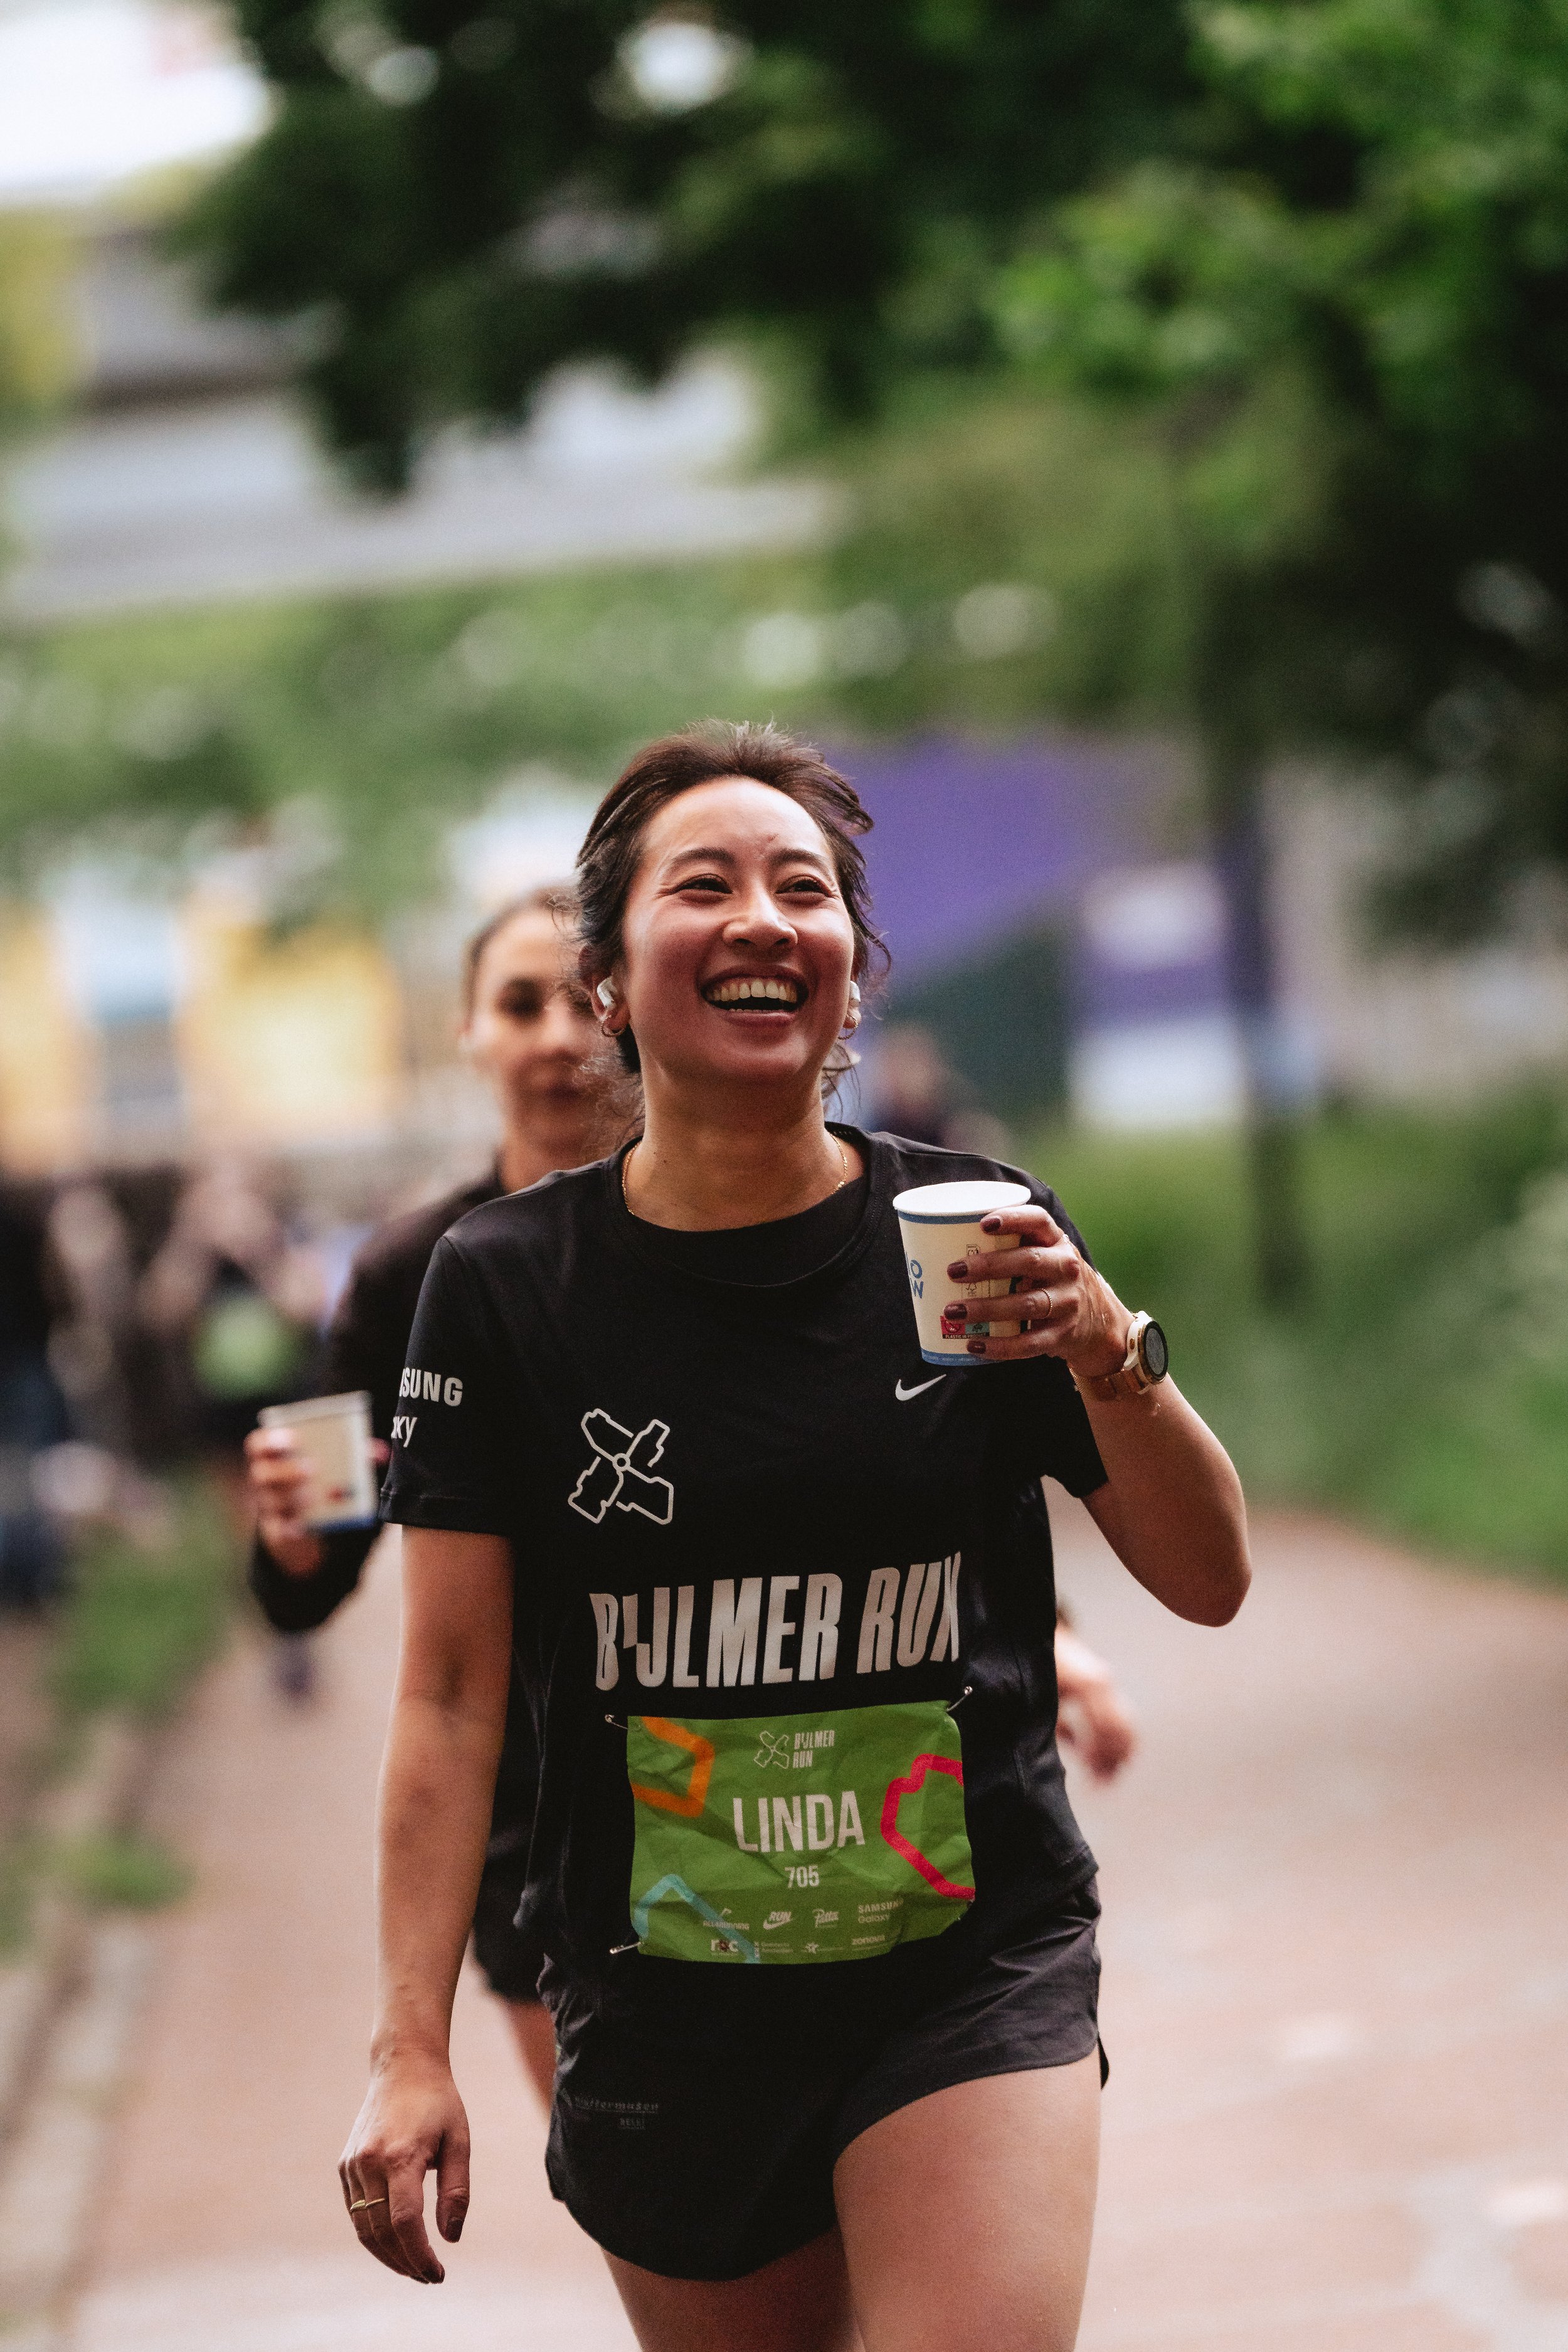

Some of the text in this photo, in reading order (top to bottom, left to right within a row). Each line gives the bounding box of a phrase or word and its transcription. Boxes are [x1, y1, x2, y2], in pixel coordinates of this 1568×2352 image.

[400, 1367, 463, 1406] SUNG
[792, 1750, 813, 1768] RUN
[733, 1791, 866, 1853] LINDA
[785, 1865, 820, 1888] 705
